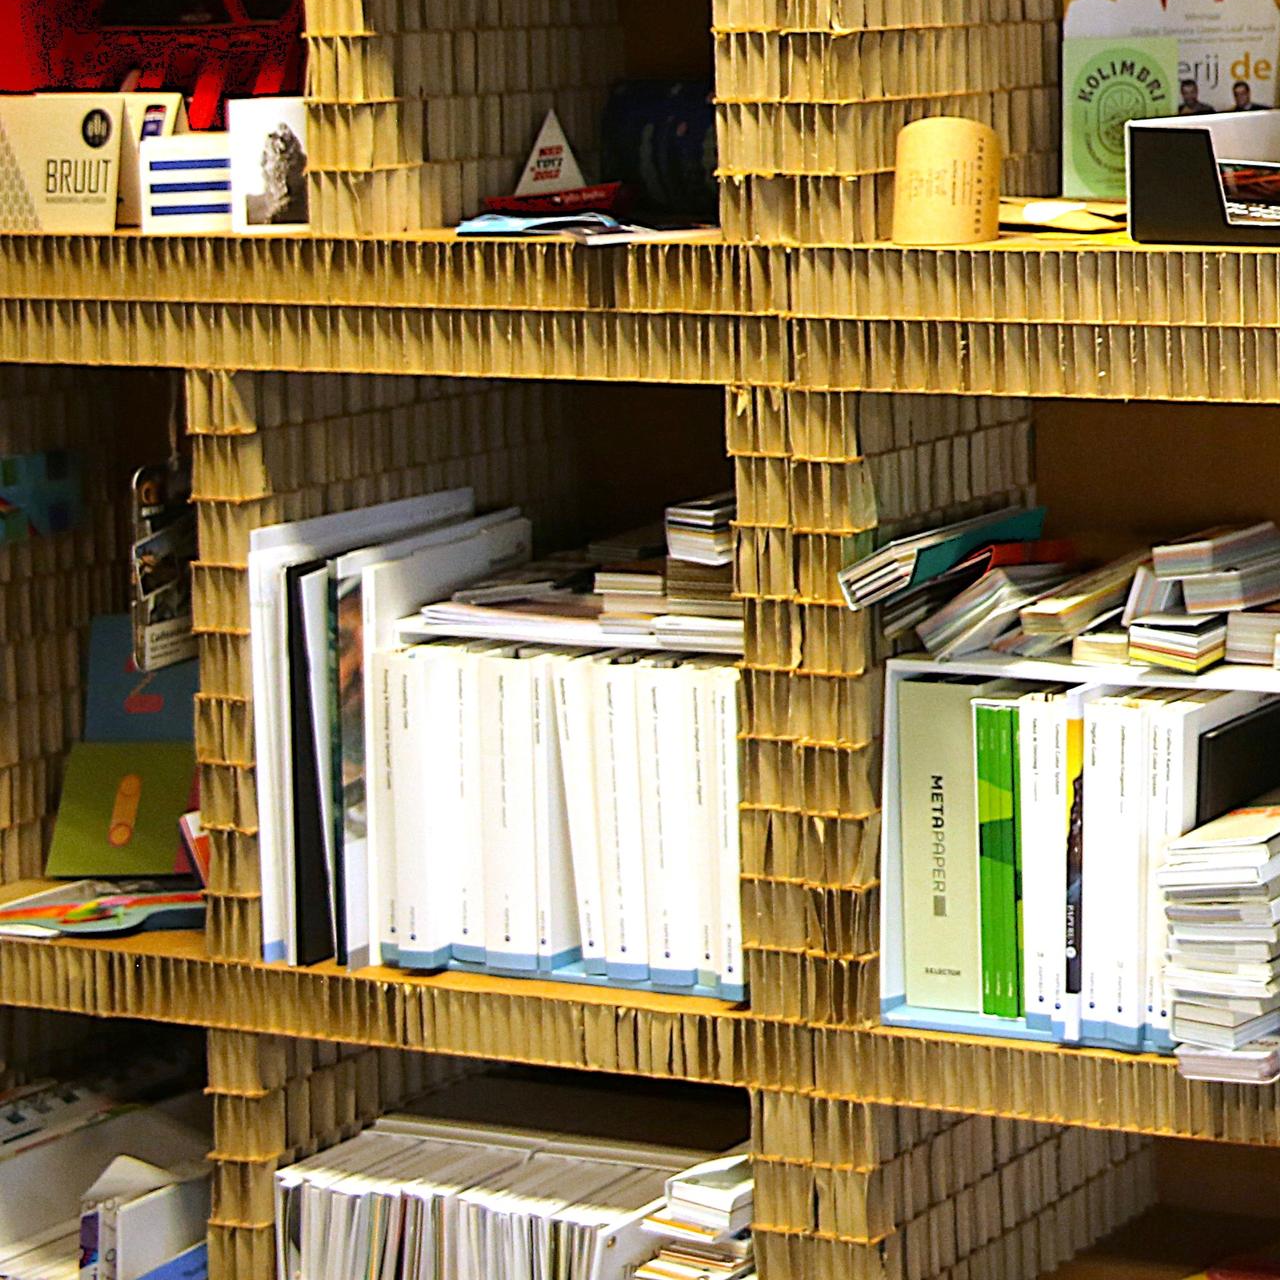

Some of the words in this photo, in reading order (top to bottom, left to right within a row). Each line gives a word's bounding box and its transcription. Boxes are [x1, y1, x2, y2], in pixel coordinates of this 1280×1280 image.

[1077, 59, 1166, 104] KOLIMBRI
[1229, 50, 1273, 81] de
[46, 158, 112, 194] BRUUT
[930, 775, 946, 892] METAPAPER
